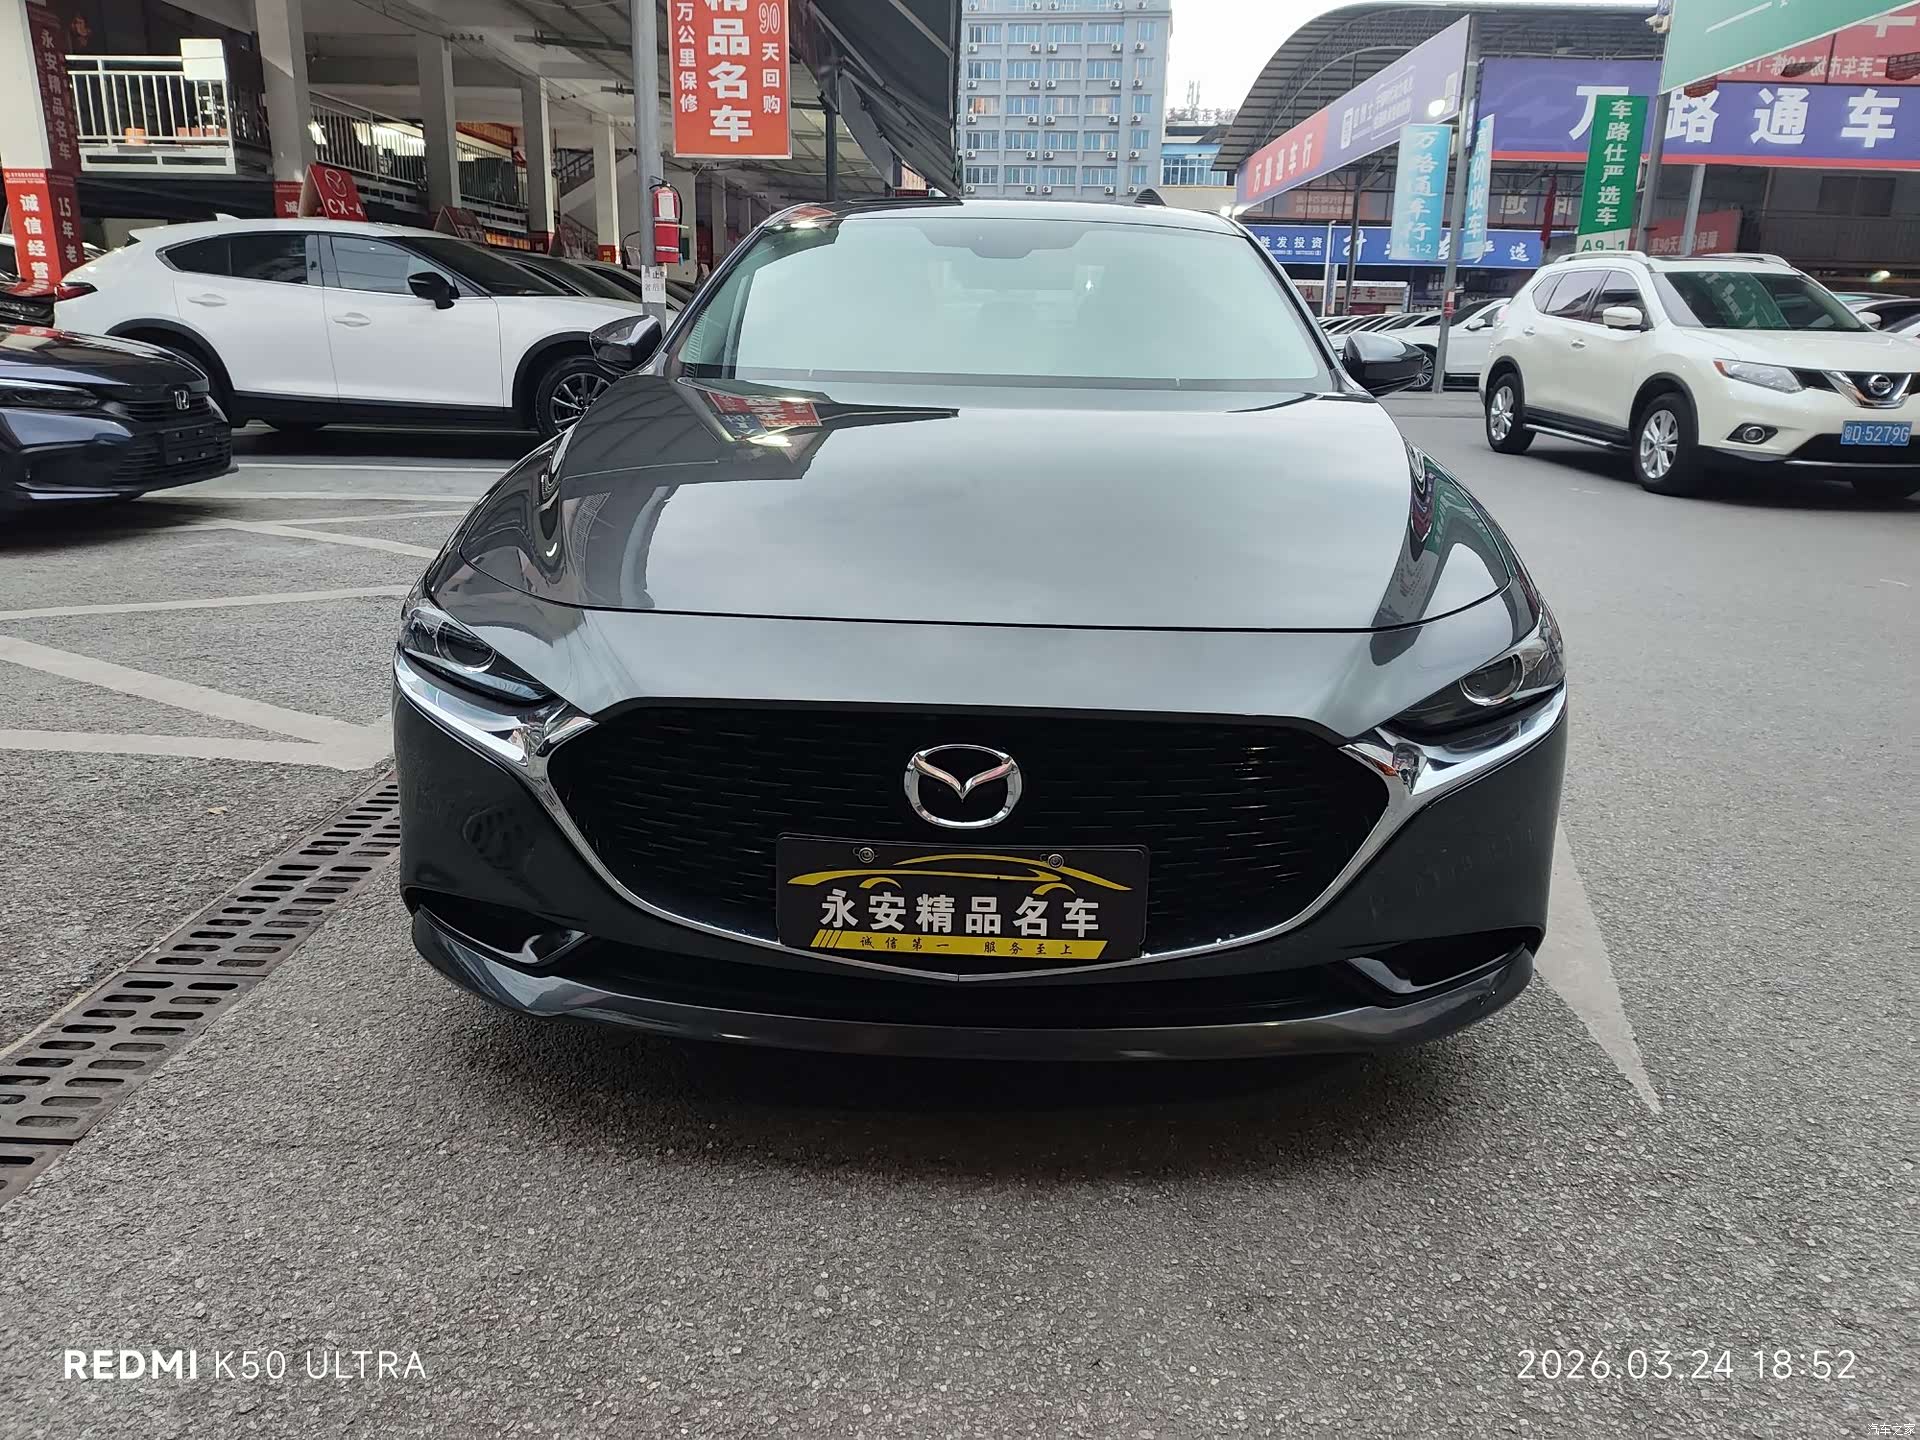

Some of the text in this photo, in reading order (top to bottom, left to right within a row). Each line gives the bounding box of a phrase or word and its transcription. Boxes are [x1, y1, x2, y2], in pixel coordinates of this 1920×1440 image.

[676, 2, 698, 113] 万公里保修
[758, 2, 781, 114] 90天回购
[1253, 132, 1313, 193] 万路通车行
[1595, 99, 1633, 226] 车路仕严选车
[20, 193, 49, 279] 诚信经营
[58, 197, 78, 263] 15年老
[328, 198, 364, 217] CX-4
[1582, 239, 1626, 250] A9-1
[820, 888, 1100, 938] 永安精品名车
[860, 935, 1074, 957] 诚信第一 服务至上
